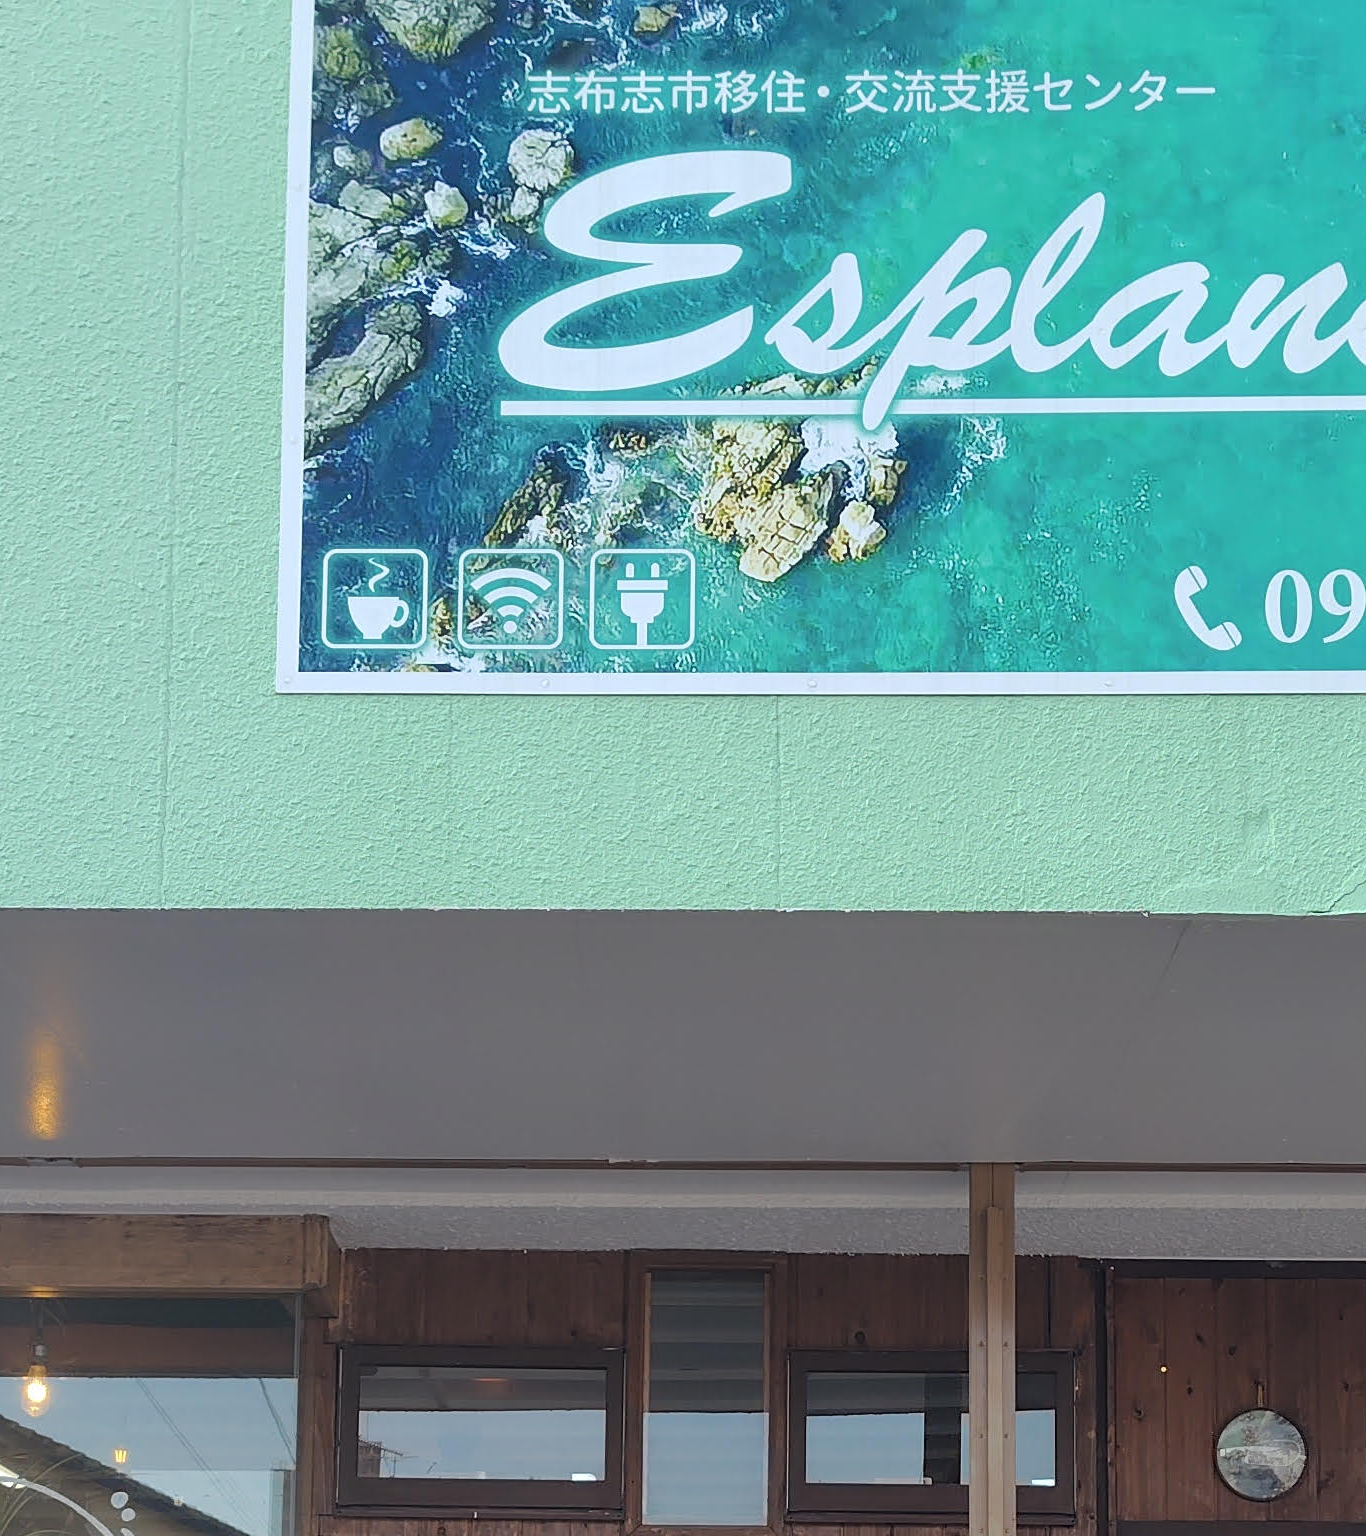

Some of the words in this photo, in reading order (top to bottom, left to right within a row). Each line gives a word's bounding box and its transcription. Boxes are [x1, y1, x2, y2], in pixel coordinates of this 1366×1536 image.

[527, 69, 1216, 117] 志布志市移住・交流支援センター
